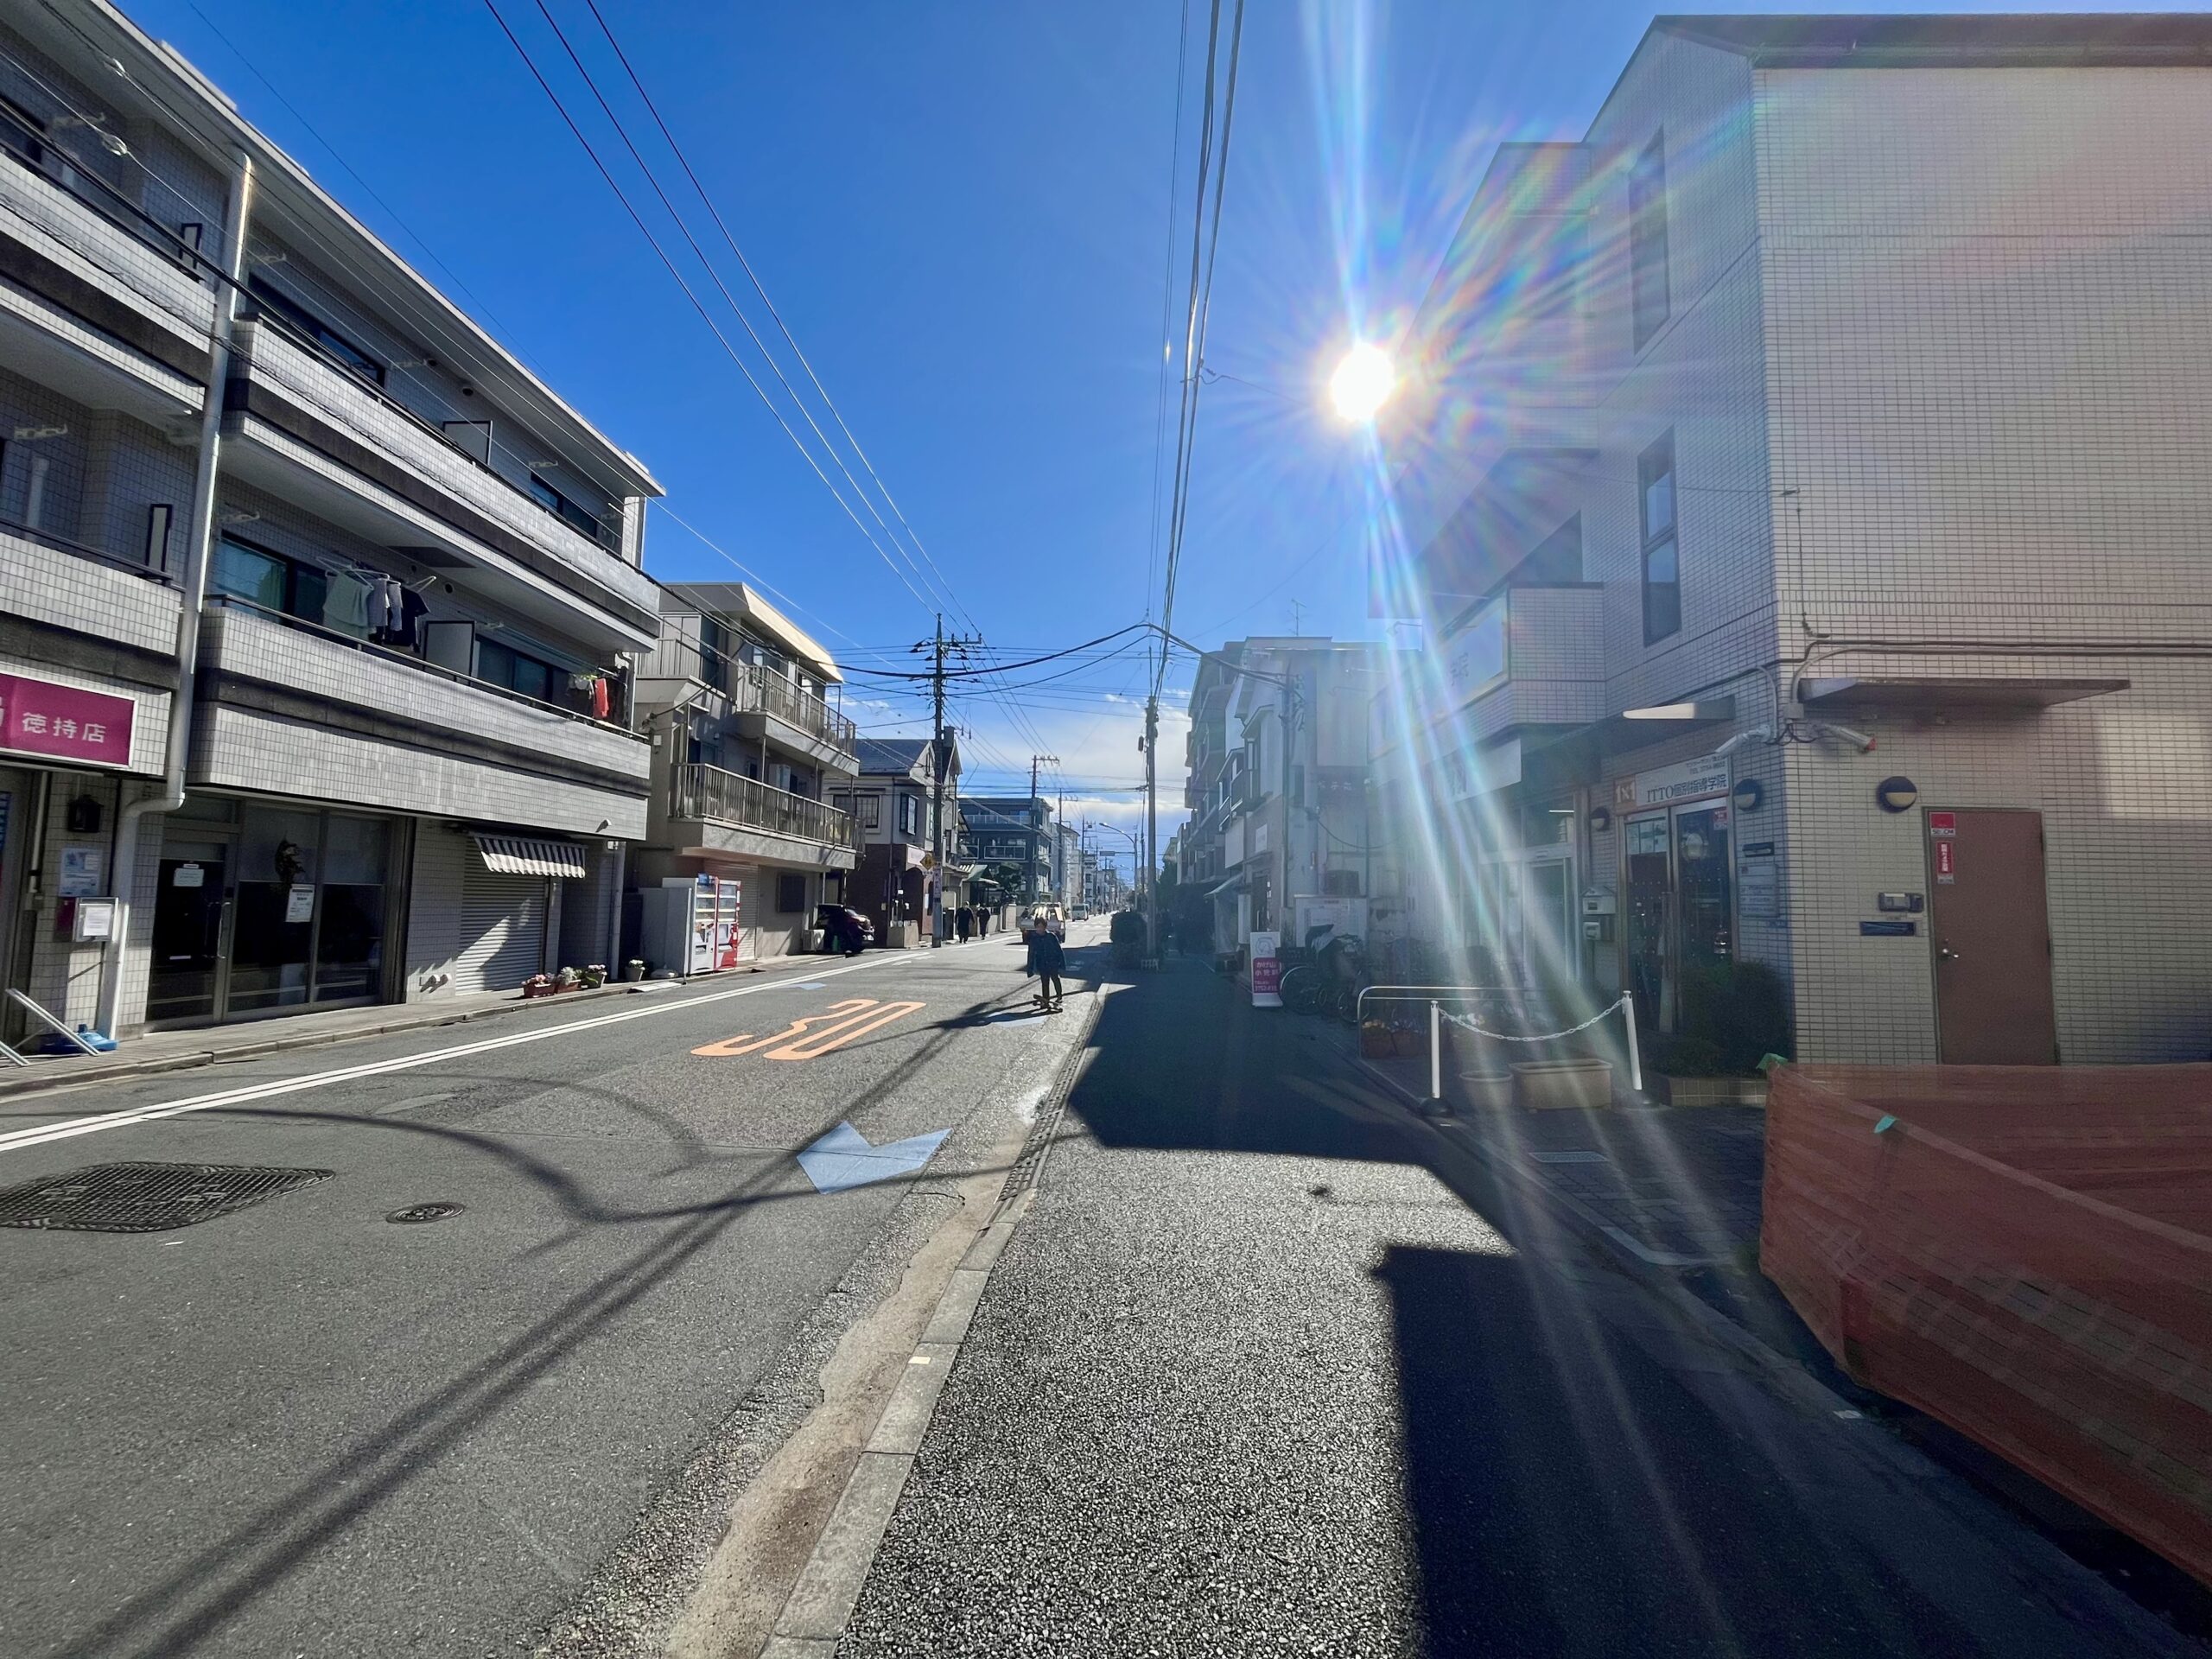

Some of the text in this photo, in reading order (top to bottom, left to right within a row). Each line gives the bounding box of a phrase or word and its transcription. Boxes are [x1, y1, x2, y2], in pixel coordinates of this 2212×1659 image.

[22, 711, 106, 744] 徳持店
[690, 999, 927, 1060] 30
